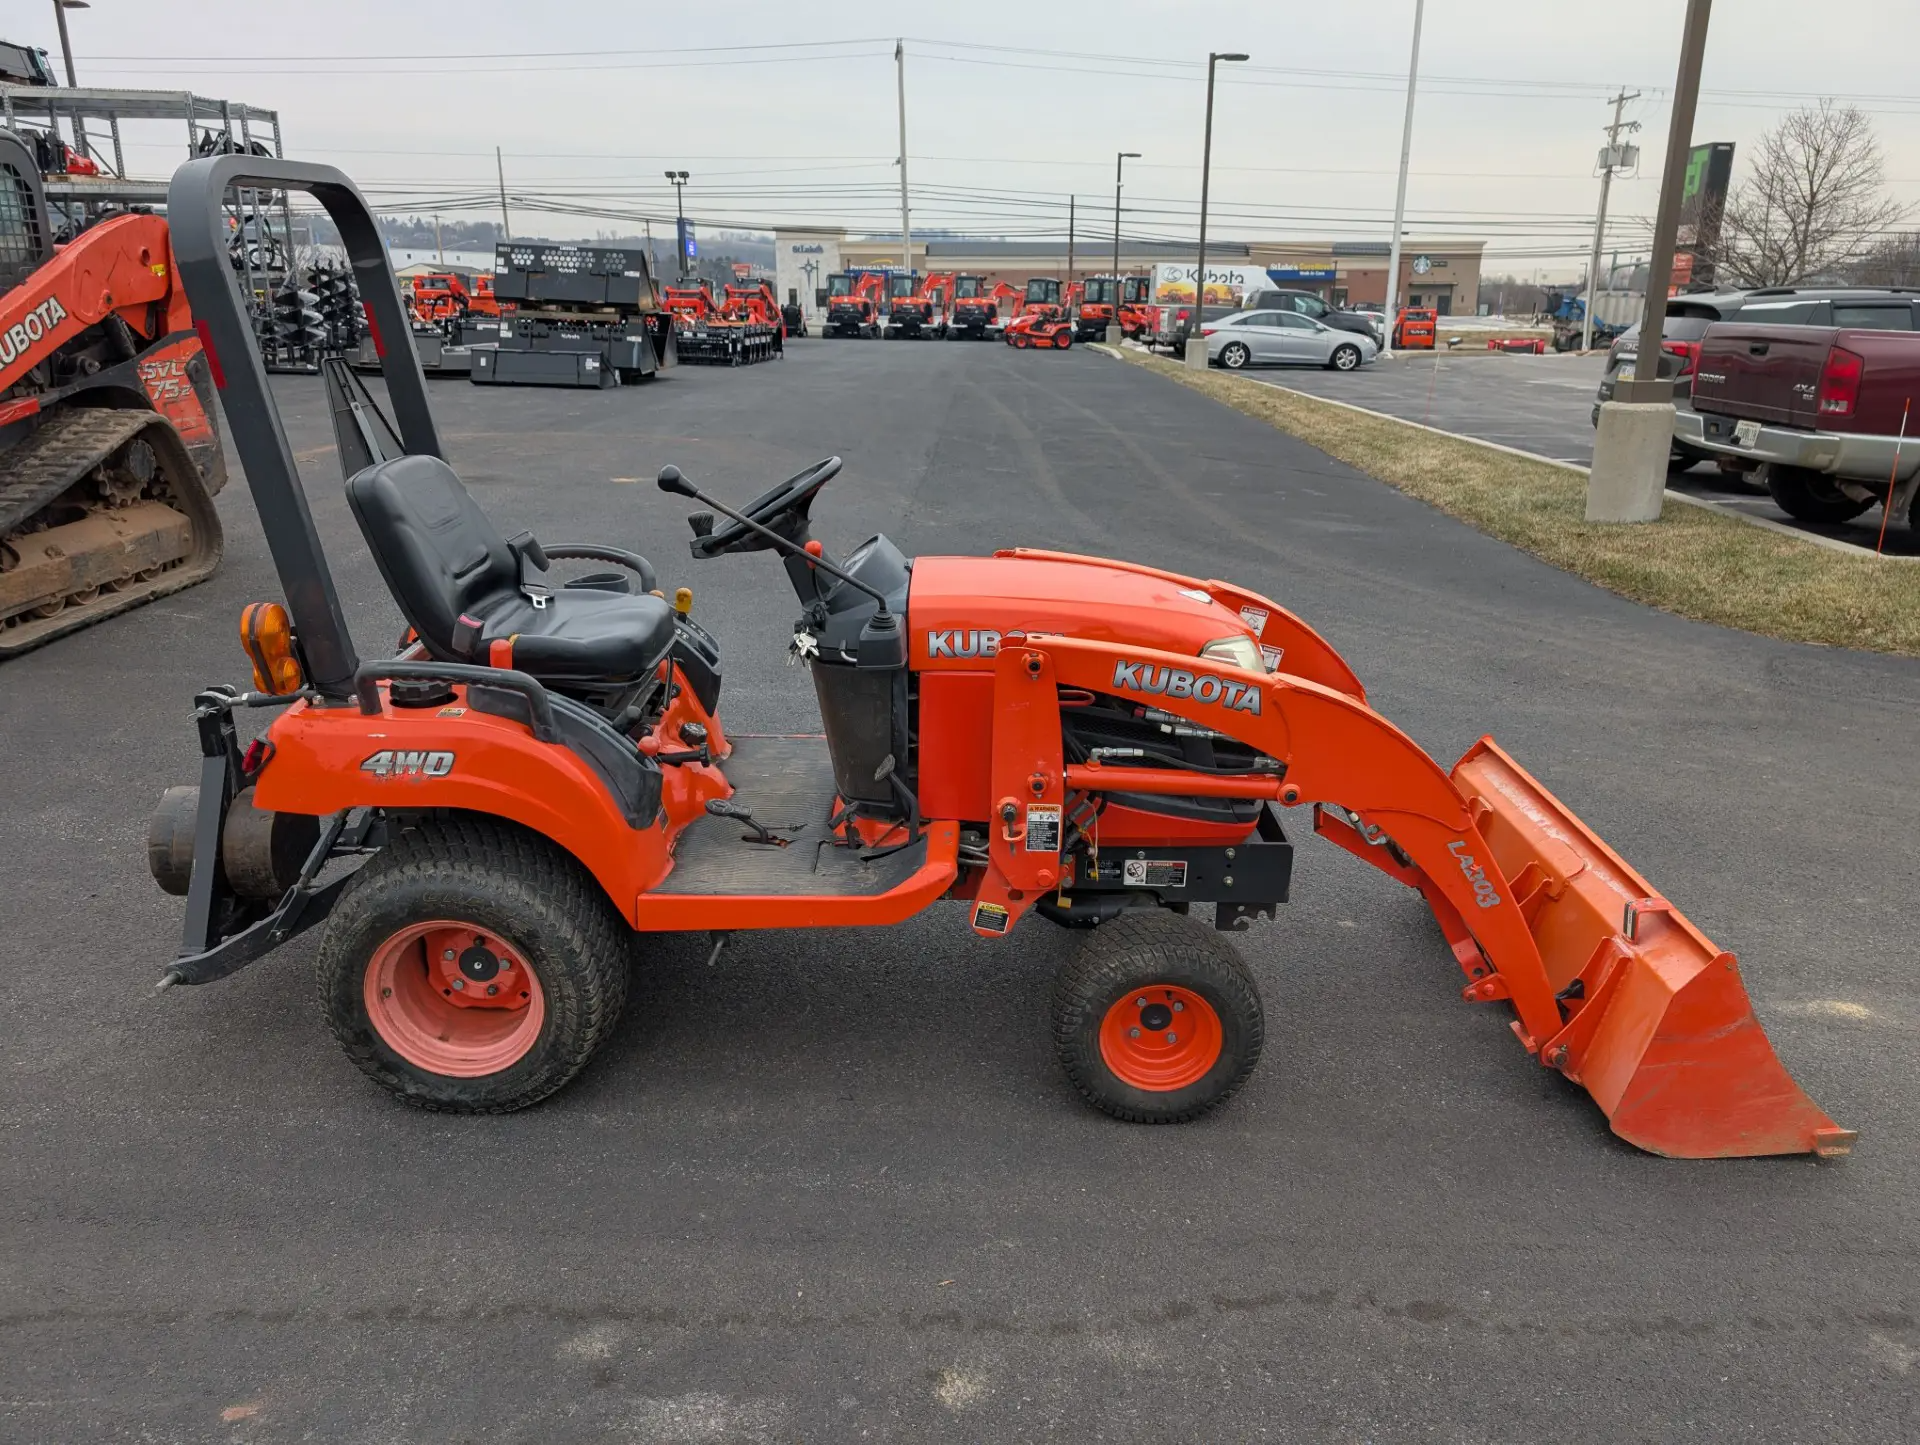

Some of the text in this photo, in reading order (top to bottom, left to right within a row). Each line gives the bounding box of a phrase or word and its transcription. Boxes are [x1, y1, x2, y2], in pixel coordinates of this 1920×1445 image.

[0, 295, 67, 370] UBOTA
[1698, 373, 1726, 384] DODGE
[1112, 660, 1262, 716] KUBOTA
[360, 749, 456, 776] 4WD
